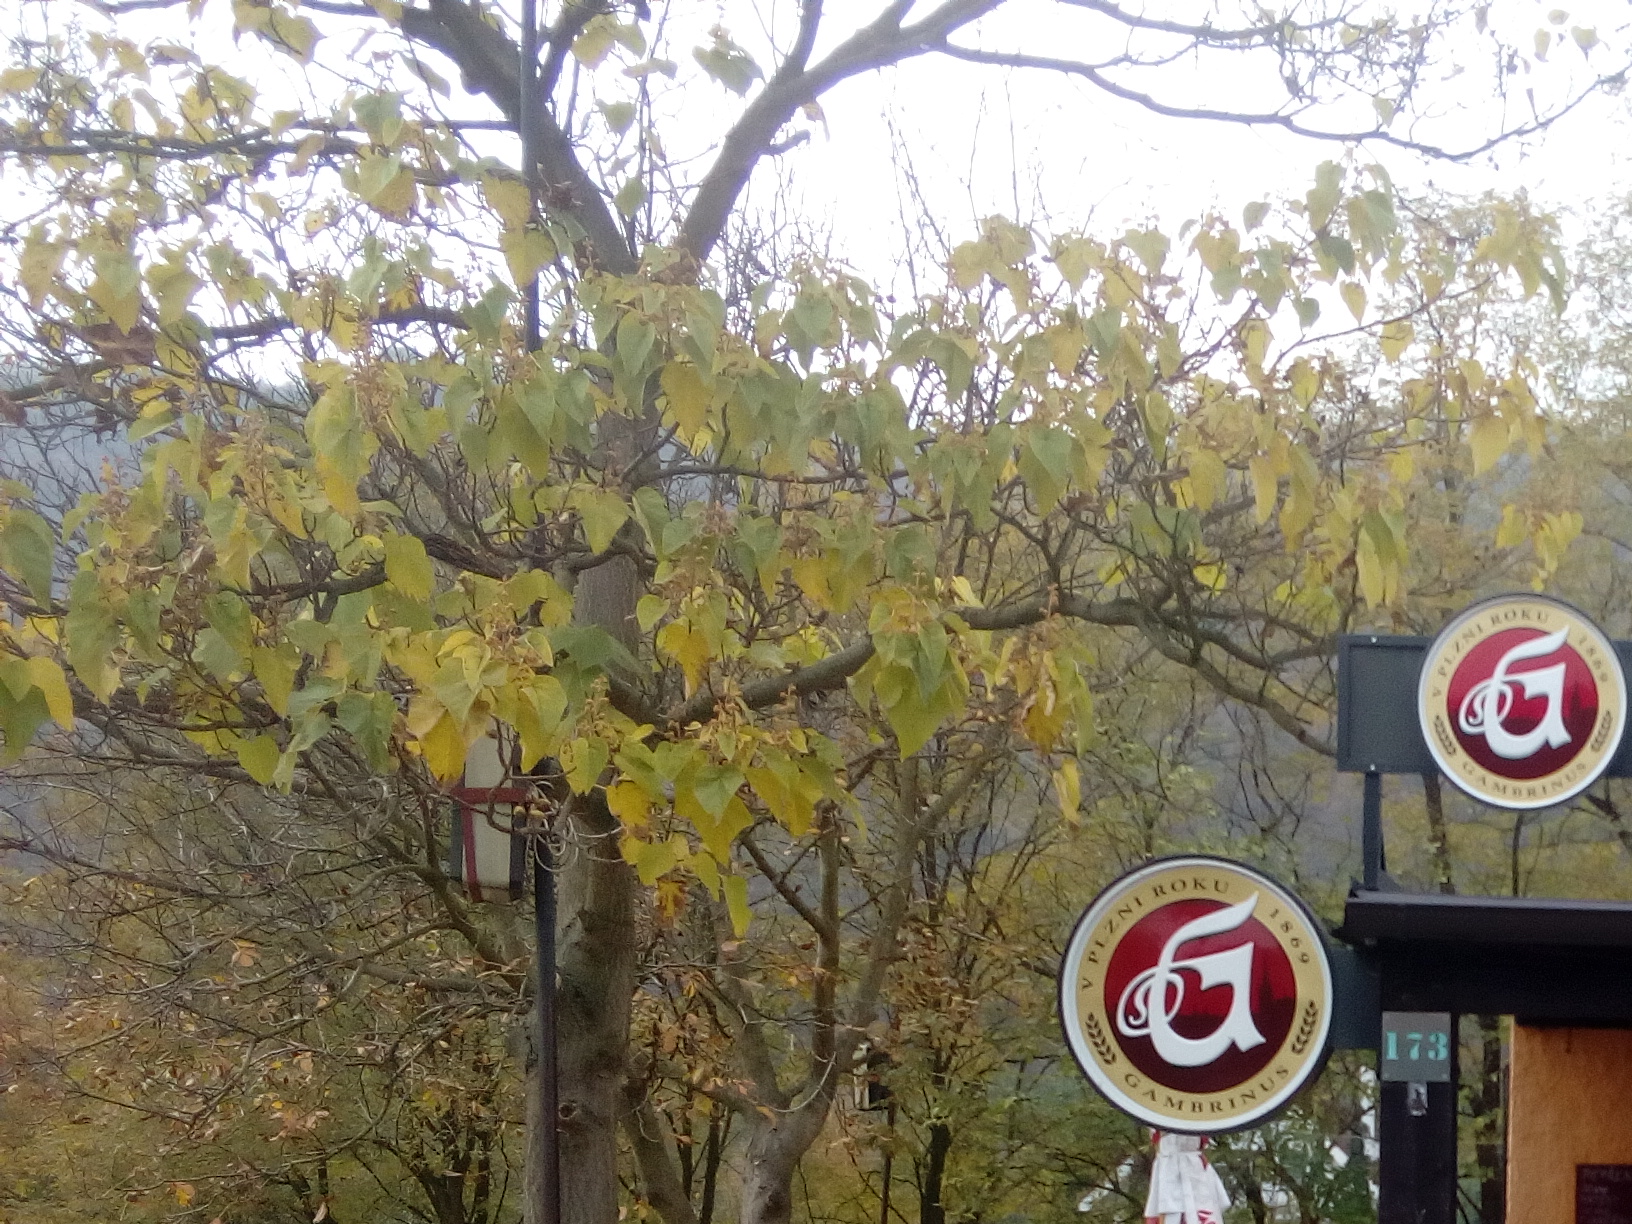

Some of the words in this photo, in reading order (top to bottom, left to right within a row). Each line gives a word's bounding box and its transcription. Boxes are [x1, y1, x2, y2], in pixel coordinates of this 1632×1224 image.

[1490, 608, 1550, 628] ROKU
[1462, 762, 1587, 798] GAMBRINUS
[1088, 896, 1144, 965] PLZNI
[1153, 876, 1230, 898] ROKU
[1268, 907, 1311, 965] 1869
[1386, 1030, 1449, 1060] 173
[1124, 1065, 1290, 1114] GAMBRINUS
